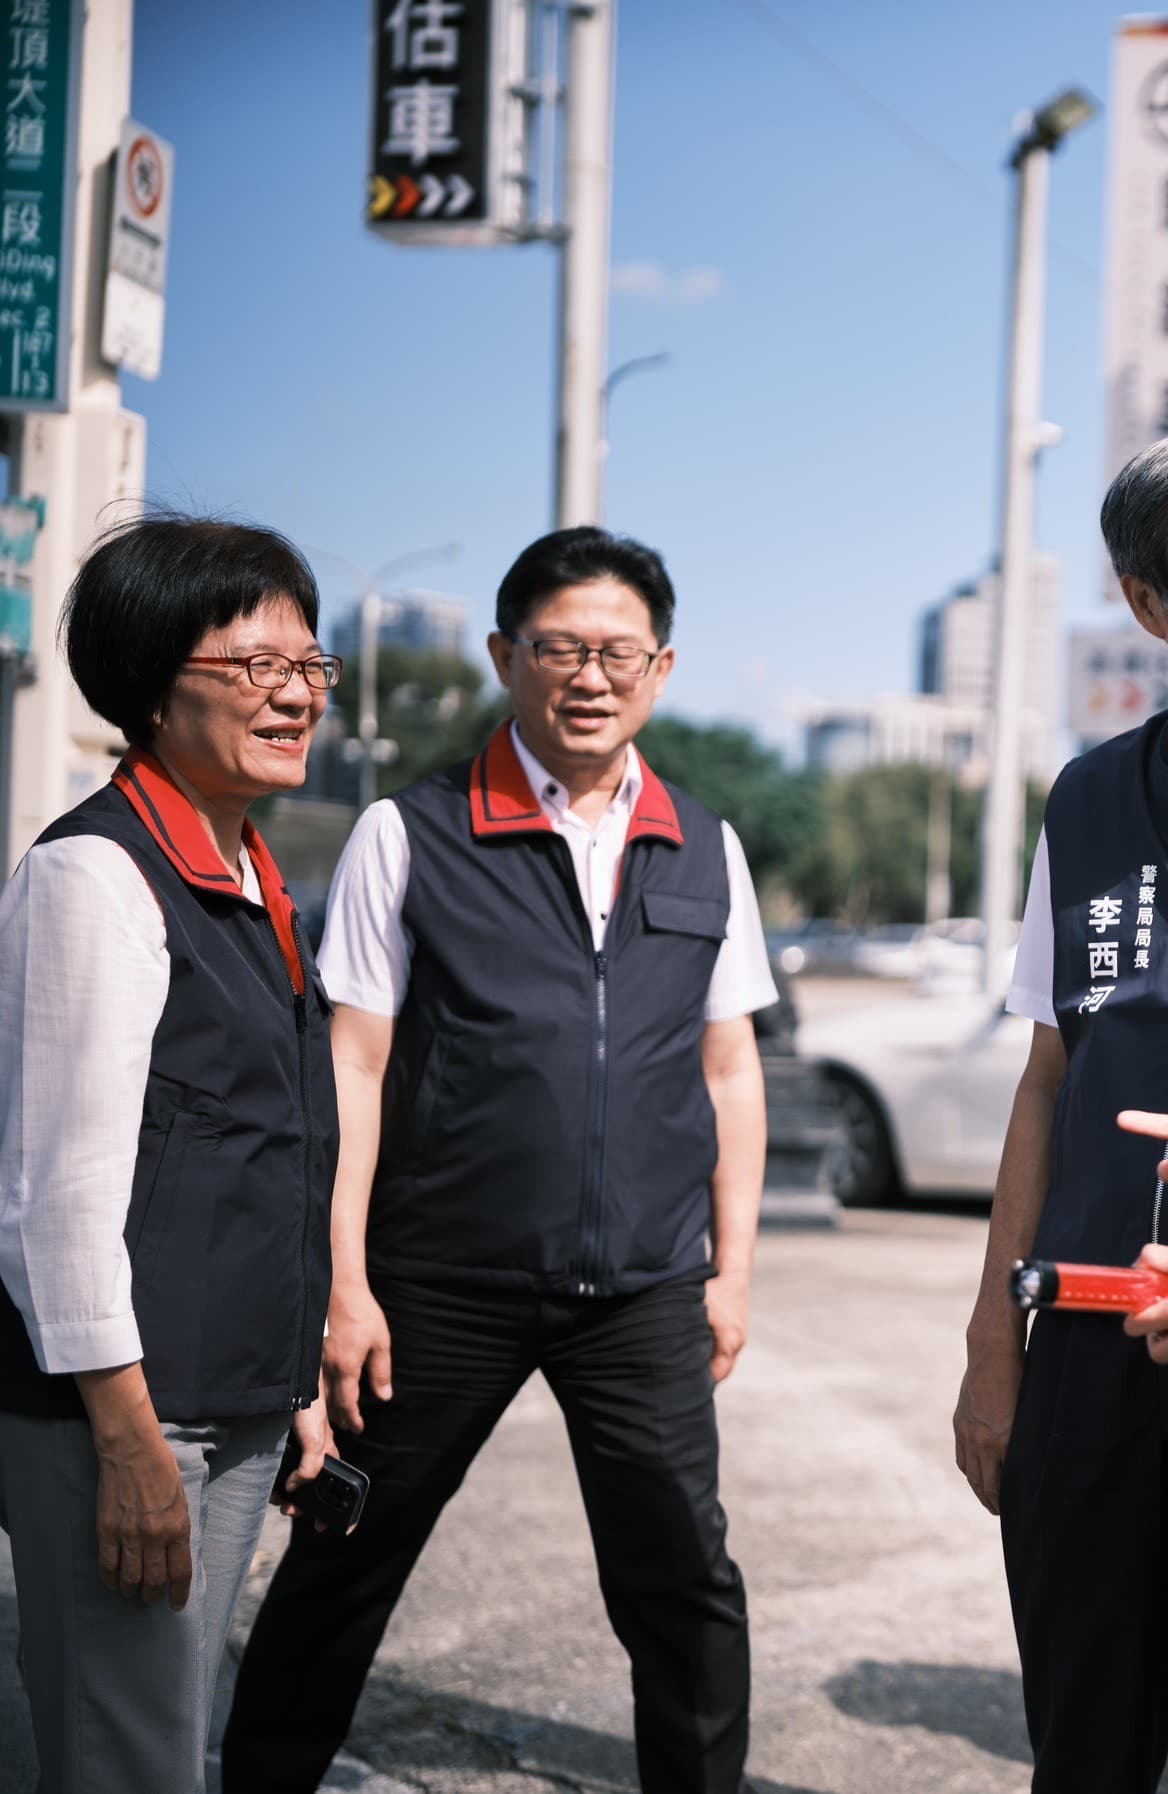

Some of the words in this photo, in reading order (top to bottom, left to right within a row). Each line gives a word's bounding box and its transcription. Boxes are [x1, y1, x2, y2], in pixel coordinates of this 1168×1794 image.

[1078, 895, 1123, 1015] 李西河
[1133, 864, 1158, 969] 警察局局長
